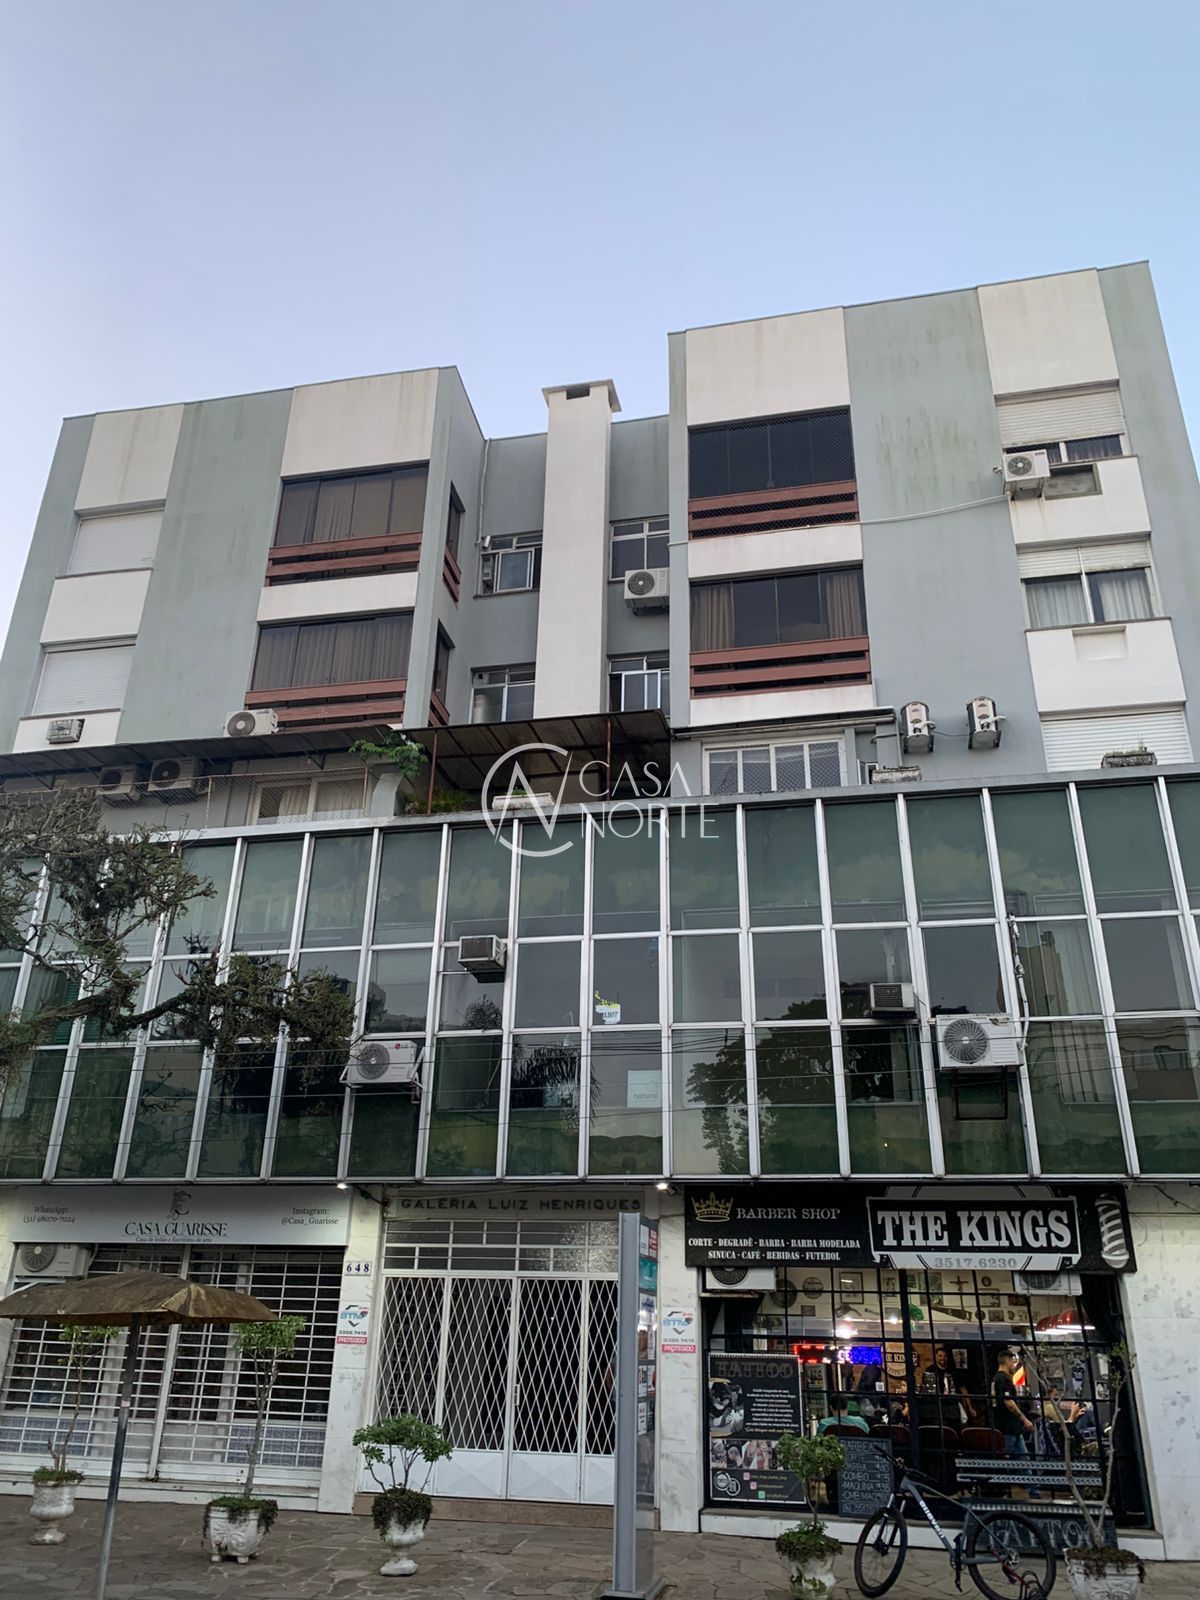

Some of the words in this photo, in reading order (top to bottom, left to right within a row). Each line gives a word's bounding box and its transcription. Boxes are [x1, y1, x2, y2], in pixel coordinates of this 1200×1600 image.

[401, 1198, 478, 1210] GALERIA
[488, 1199, 529, 1210] LUIZ
[540, 1199, 641, 1210] HENRIQUES
[292, 1207, 330, 1216] Instagram:
[736, 1207, 798, 1220] BARBER
[801, 1208, 841, 1220] SHOP
[281, 1217, 339, 1226] @Casa_Guarisse
[124, 1221, 161, 1236] CASA
[163, 1221, 229, 1237] GUARISSE
[876, 1210, 949, 1247] THE
[956, 1209, 1072, 1249] KINGS
[688, 1237, 714, 1247] CORTE
[718, 1236, 754, 1247] DEGRADÊ
[758, 1238, 785, 1248] BARBA
[791, 1239, 818, 1248] BARBA
[818, 1239, 861, 1249] MODELADA
[707, 1250, 736, 1260] SINUCA
[741, 1249, 761, 1260] CAFÉ
[766, 1251, 800, 1260] BEBIDAS
[805, 1251, 841, 1261] FUTEBOL
[346, 1263, 370, 1273] 648
[934, 1257, 1018, 1269] 3517.6230
[715, 1361, 794, 1379] TATTOO
